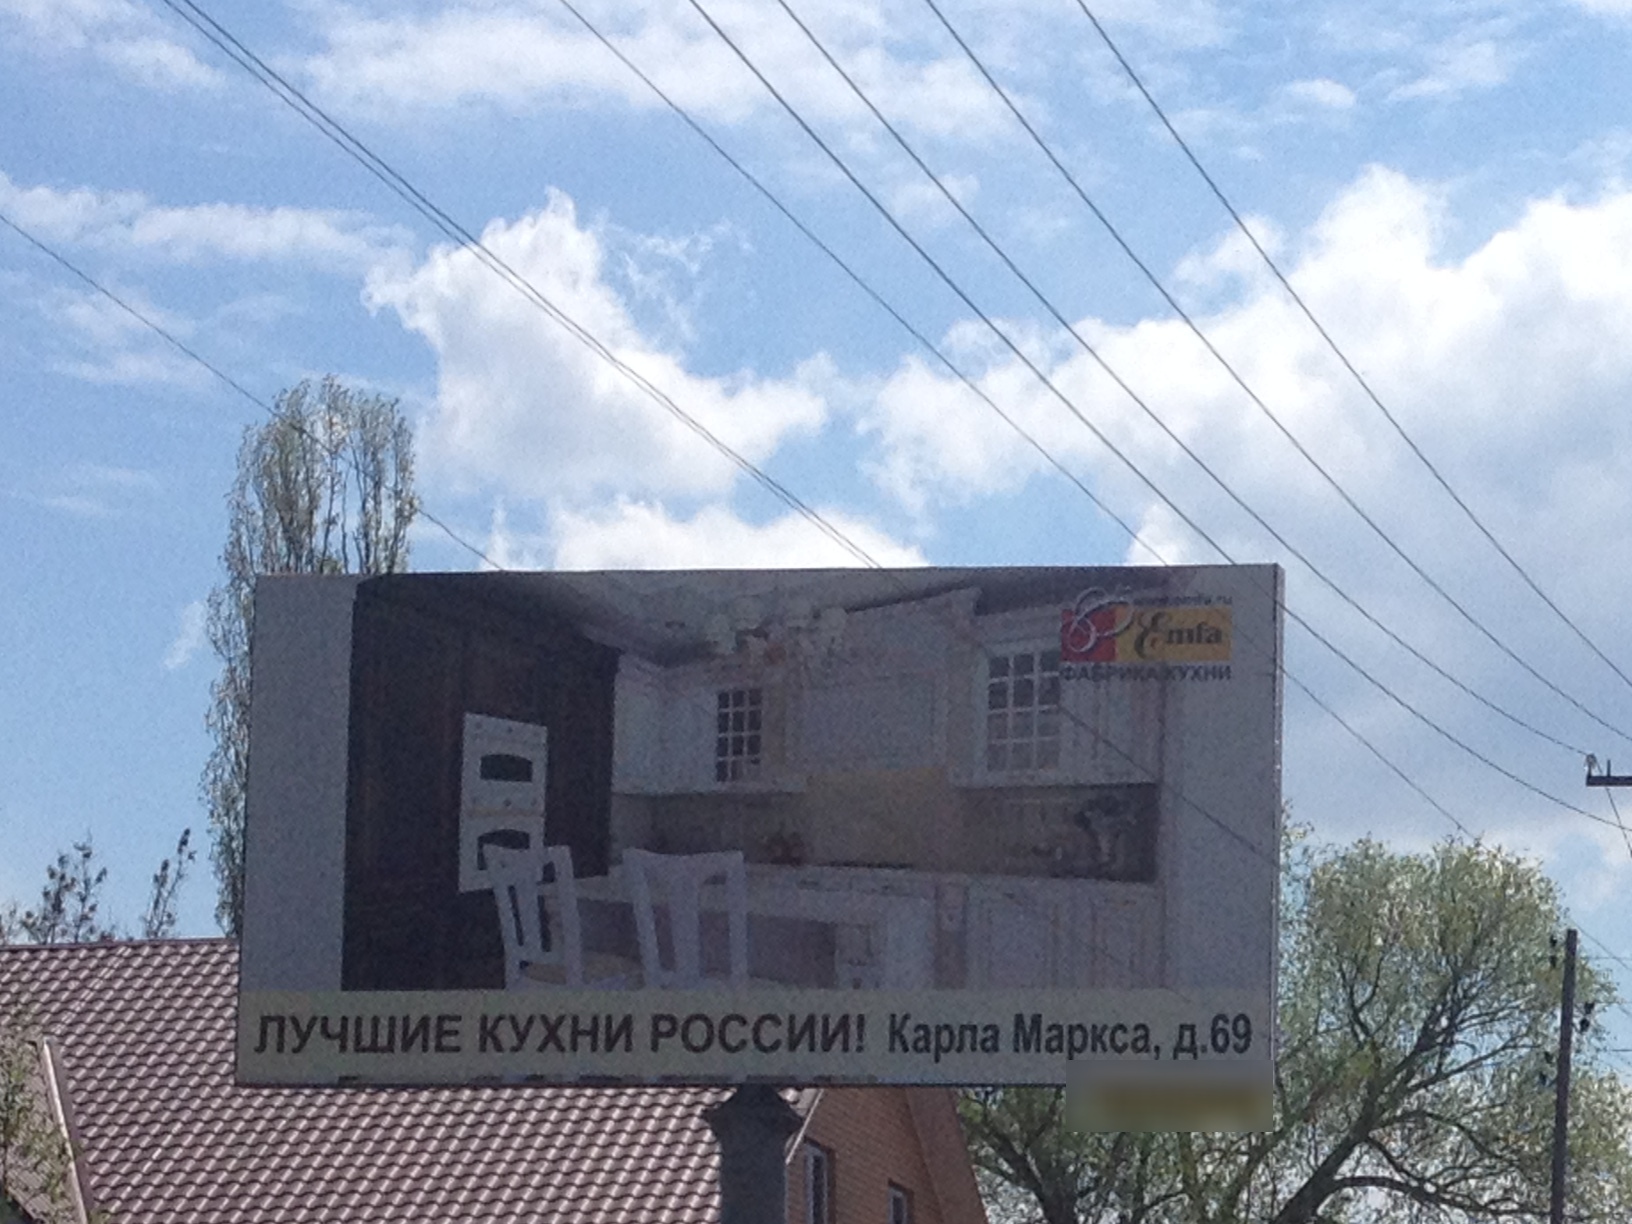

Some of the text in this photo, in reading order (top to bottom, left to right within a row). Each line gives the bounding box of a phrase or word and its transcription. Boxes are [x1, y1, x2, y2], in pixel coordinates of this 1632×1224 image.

[1134, 611, 1223, 659] Emfa
[1060, 664, 1233, 681] ФАБРИКА КУХНИ
[253, 1012, 1253, 1063] ЛУЧШИЕ КУХНИ РОССИИ! Карла Маркса, д.69
